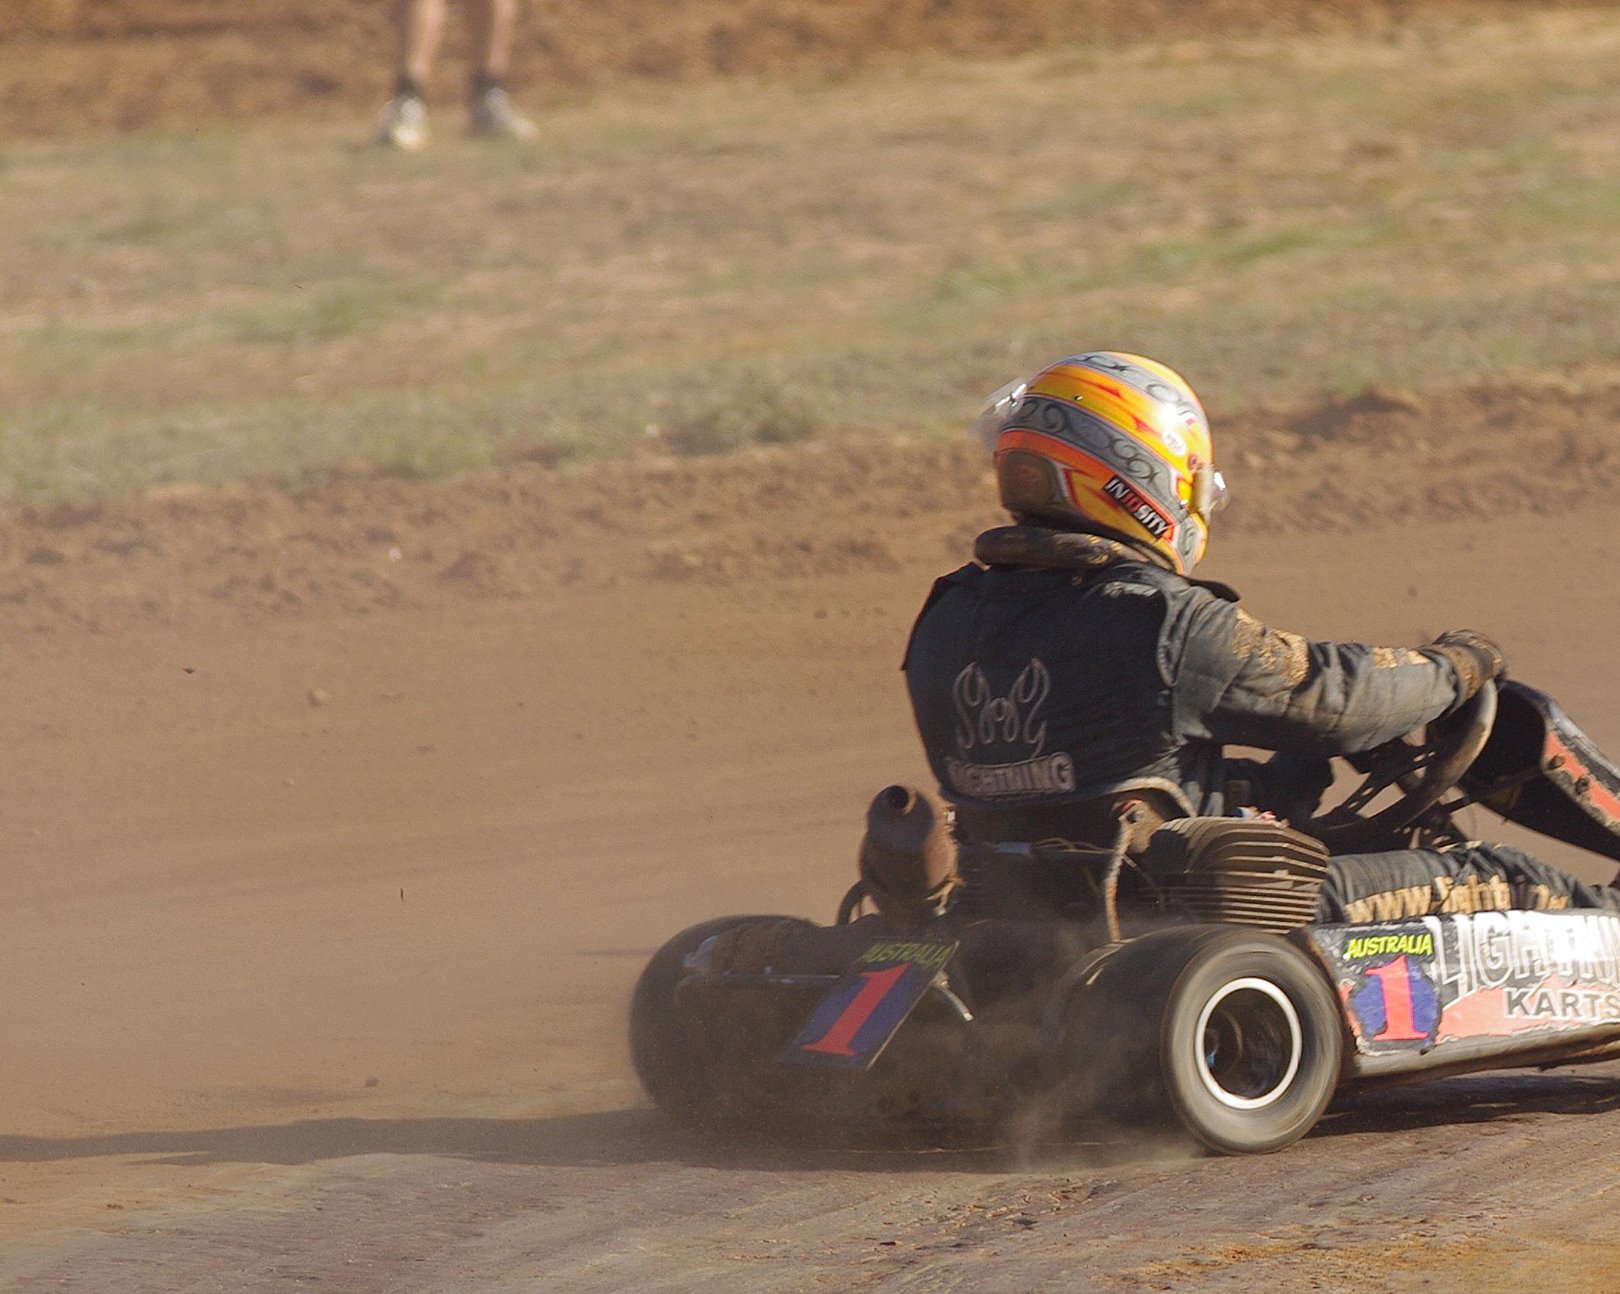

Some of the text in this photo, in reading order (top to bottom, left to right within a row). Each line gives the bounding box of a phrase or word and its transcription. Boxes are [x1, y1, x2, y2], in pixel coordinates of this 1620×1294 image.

[1344, 933, 1432, 960] AUSTRALIA
[802, 962, 912, 1057] 1
[1365, 956, 1430, 1042] 1
